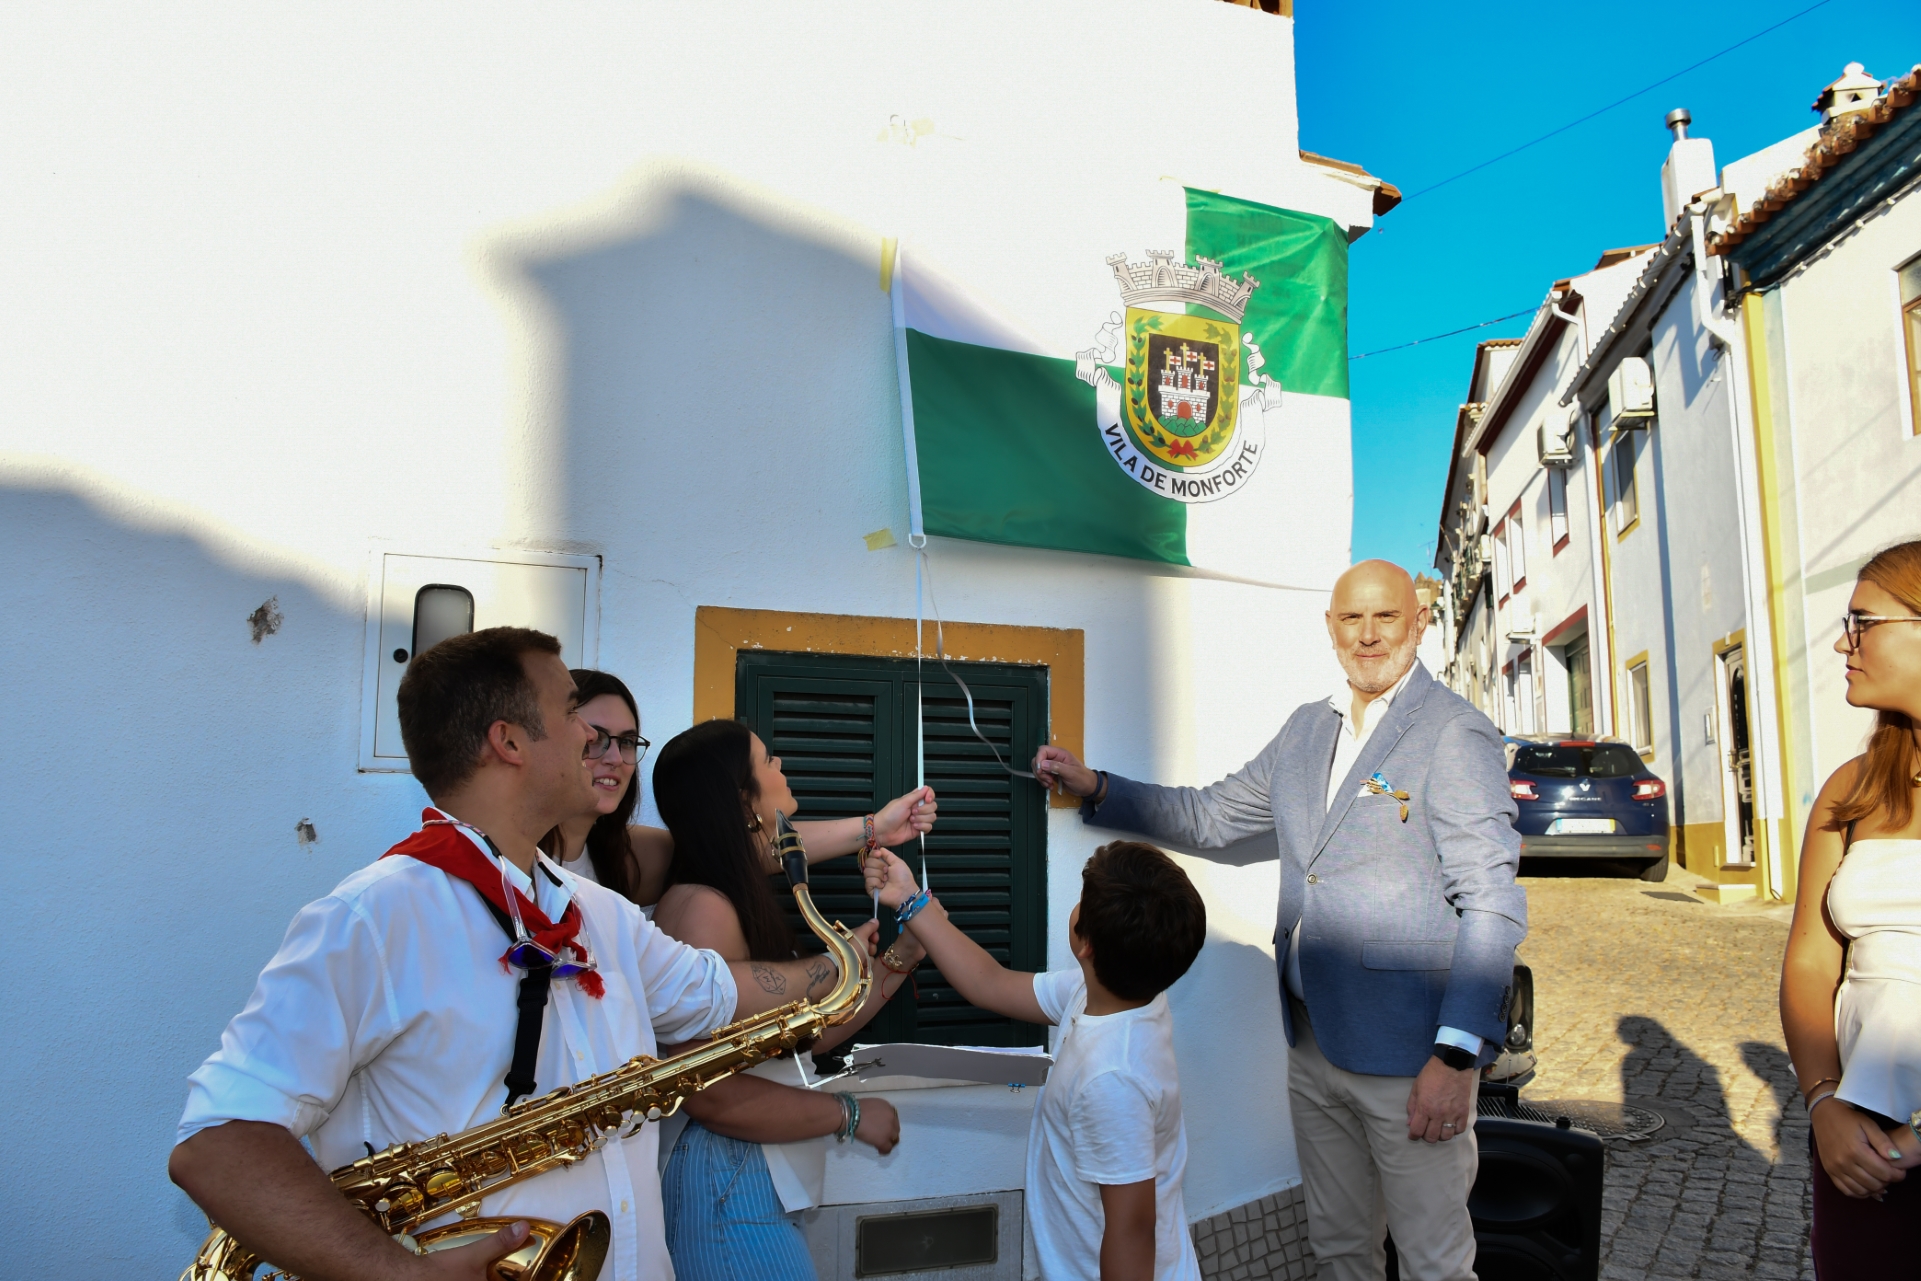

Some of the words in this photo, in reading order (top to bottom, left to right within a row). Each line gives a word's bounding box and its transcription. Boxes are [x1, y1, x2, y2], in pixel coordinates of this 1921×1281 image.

[1105, 423, 1138, 472] VILA
[1140, 465, 1168, 491] DE
[1171, 440, 1258, 497] MONFORTE
